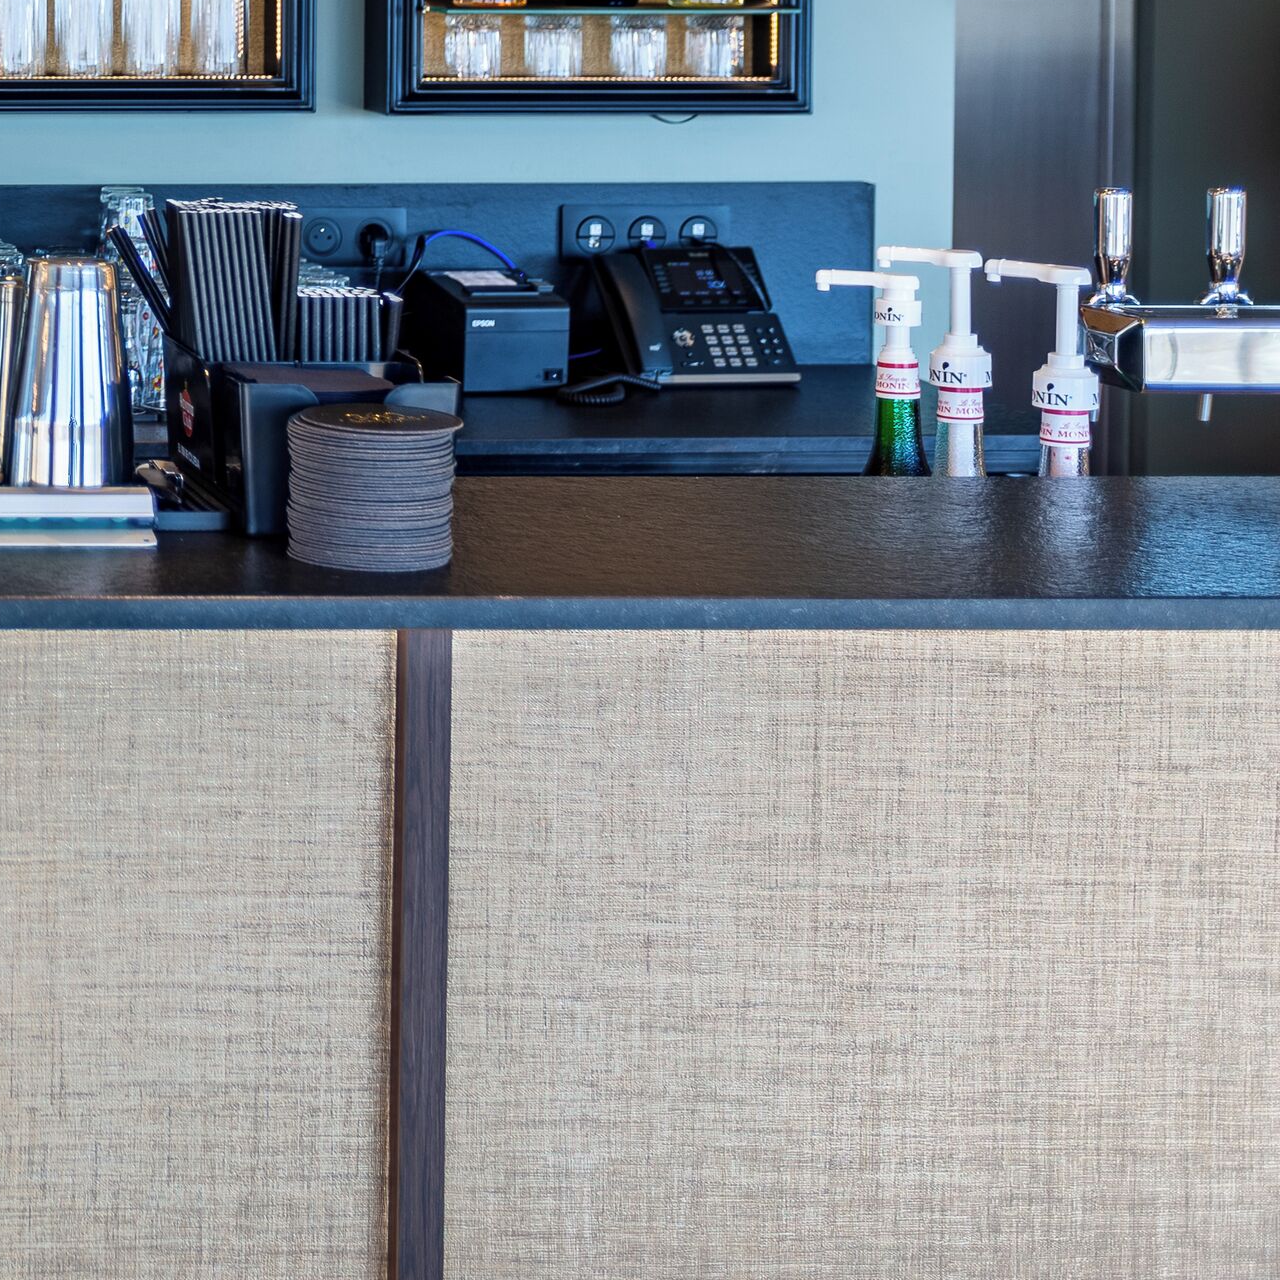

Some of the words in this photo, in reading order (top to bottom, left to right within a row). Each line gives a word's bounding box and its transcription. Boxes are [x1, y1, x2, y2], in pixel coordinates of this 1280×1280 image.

[874, 308, 904, 322] ONIN
[472, 319, 496, 328] EPSON
[876, 381, 910, 390] MONIN
